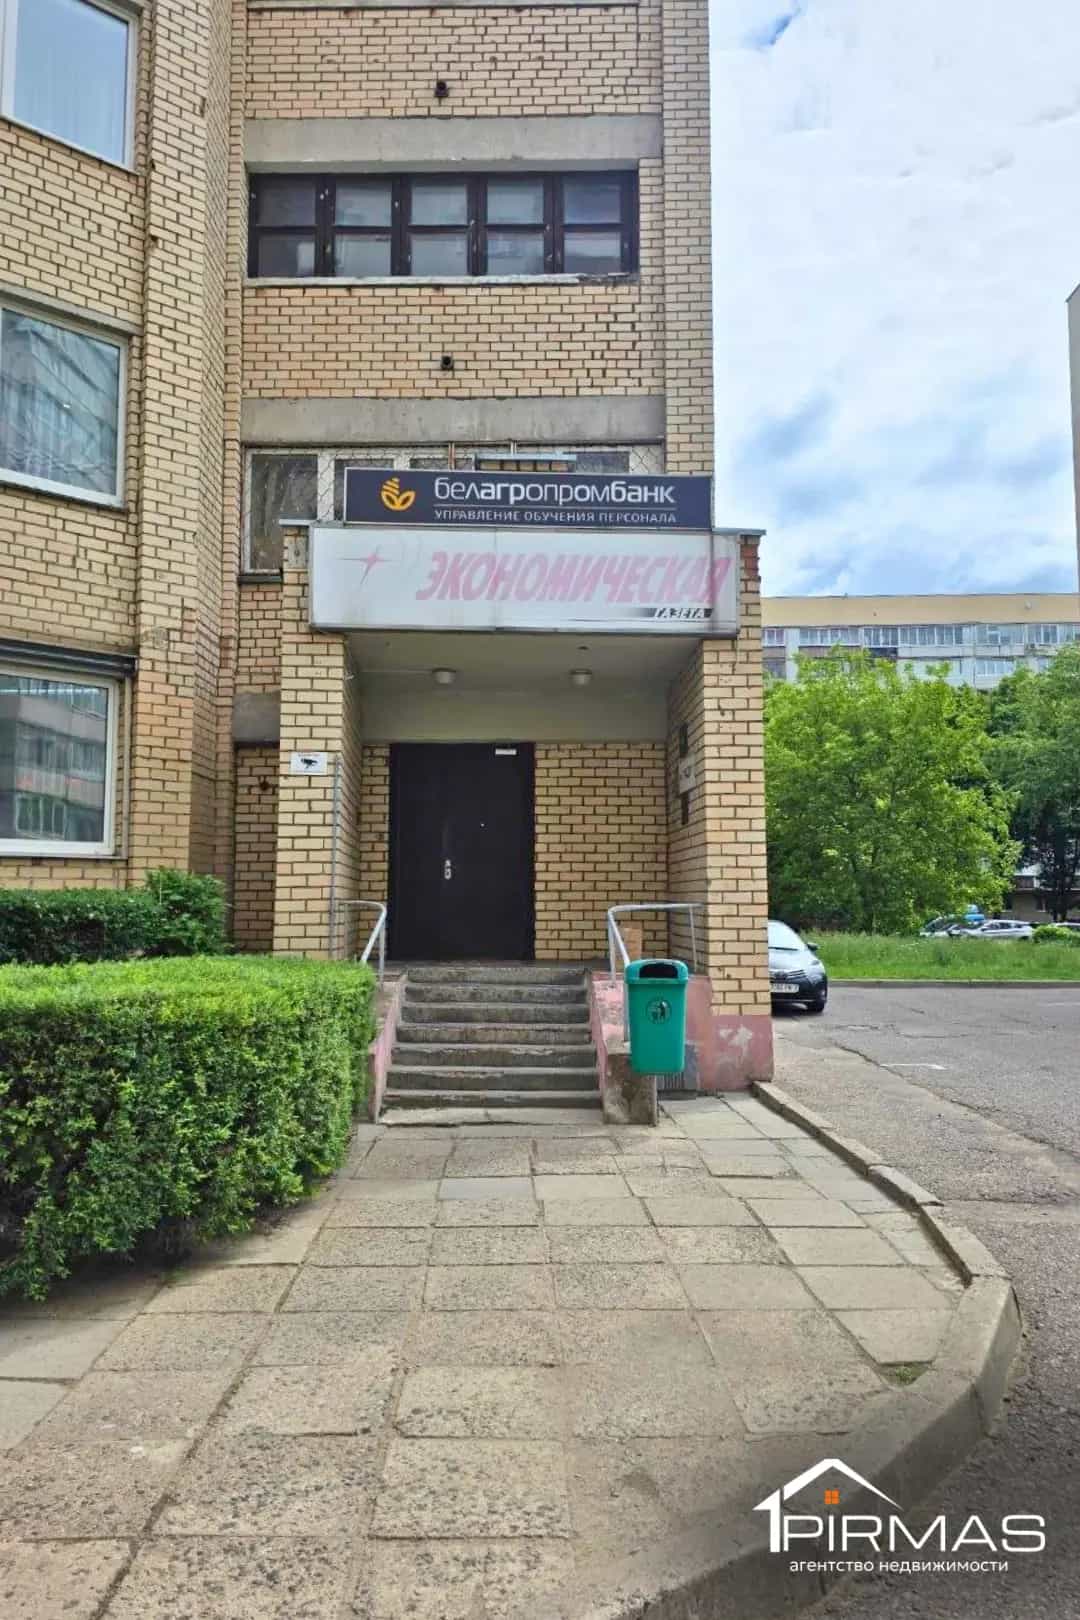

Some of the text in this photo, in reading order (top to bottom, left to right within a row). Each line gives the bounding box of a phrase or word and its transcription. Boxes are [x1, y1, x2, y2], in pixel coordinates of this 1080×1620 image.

[434, 477, 676, 505] белагропромбанк
[433, 509, 677, 524] УПРАВЛЕНИЕ ОБУЧЕНИЯ ПЕРСОНАЛА
[415, 551, 732, 603] ЭКОНОМИЧЕСКАЯ
[653, 607, 706, 619] ГАЗЕТА
